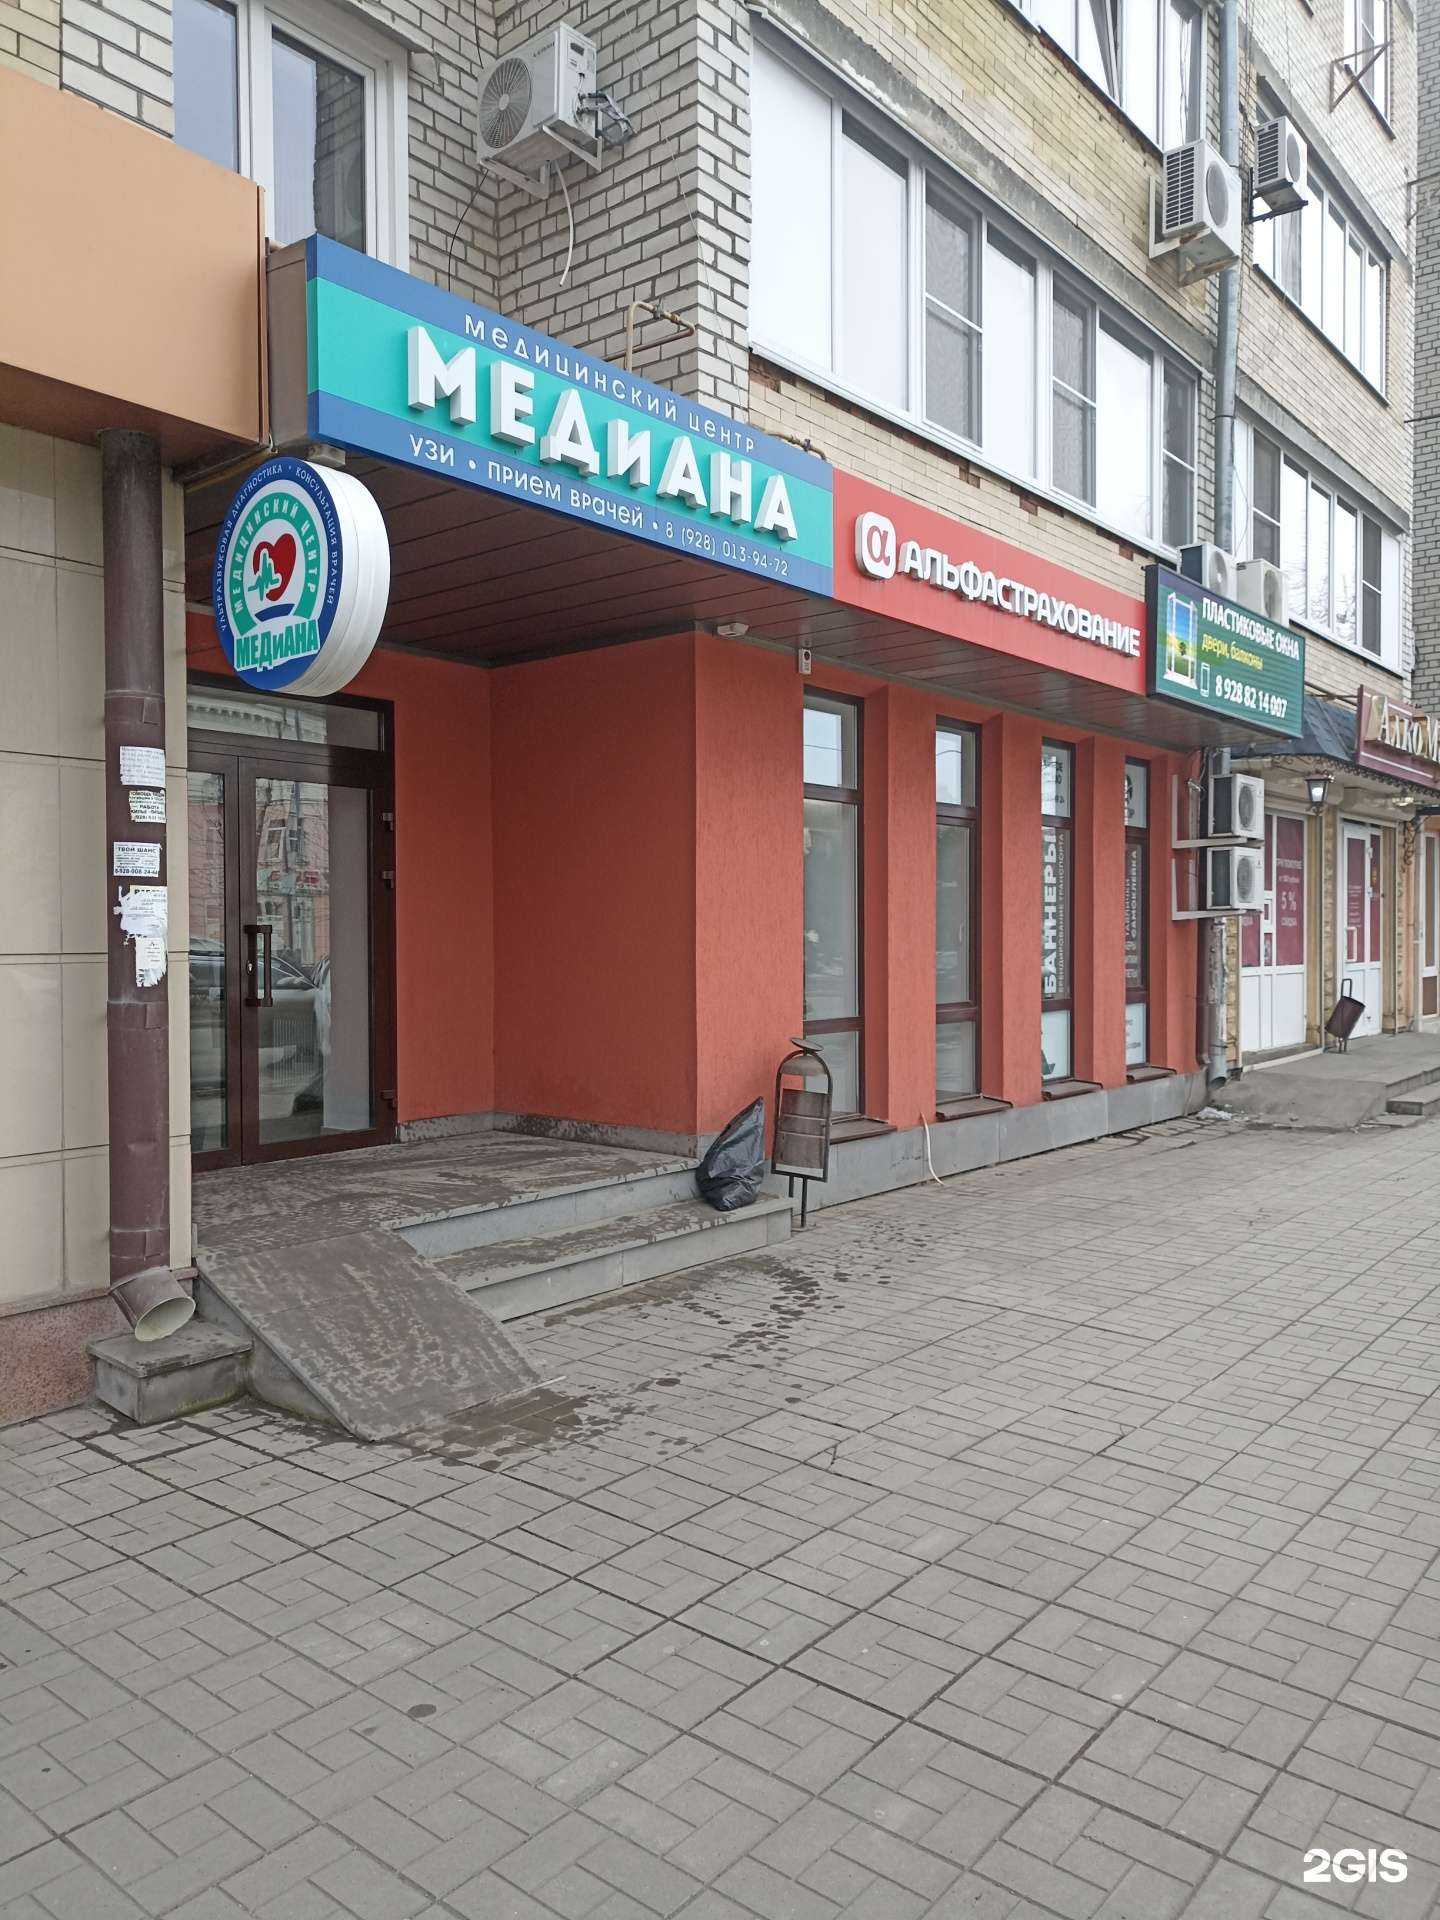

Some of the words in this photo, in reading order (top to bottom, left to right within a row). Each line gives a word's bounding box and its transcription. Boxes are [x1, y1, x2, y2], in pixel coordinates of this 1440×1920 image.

[689, 412, 754, 453] центр
[232, 463, 283, 518] ДИАГНОСТИКА
[488, 460, 561, 502] прием
[570, 487, 644, 529] врачей
[665, 521, 674, 538] 8
[681, 526, 716, 556] (928)
[722, 540, 788, 576] 013-94-72
[232, 497, 298, 615] МЕДИЦИНСКИЙ
[301, 520, 318, 593] ЦЕНТР
[295, 466, 337, 545] КОНСУЛЬТАЦИЯ
[326, 551, 338, 605] ВРАЧЕЙ
[898, 540, 1141, 658] АЛЬФАСТРАХОВАНИЕ
[1202, 597, 1275, 650] ПЛАСТИКОВЫЕ
[1275, 632, 1300, 661] ОКНА
[1201, 633, 1230, 659] двери,
[1230, 640, 1264, 672] балконы
[1215, 674, 1223, 697] 8
[1224, 679, 1242, 704] 928
[1243, 687, 1257, 709] 82
[1258, 692, 1269, 714] 14
[1269, 695, 1288, 719] 007
